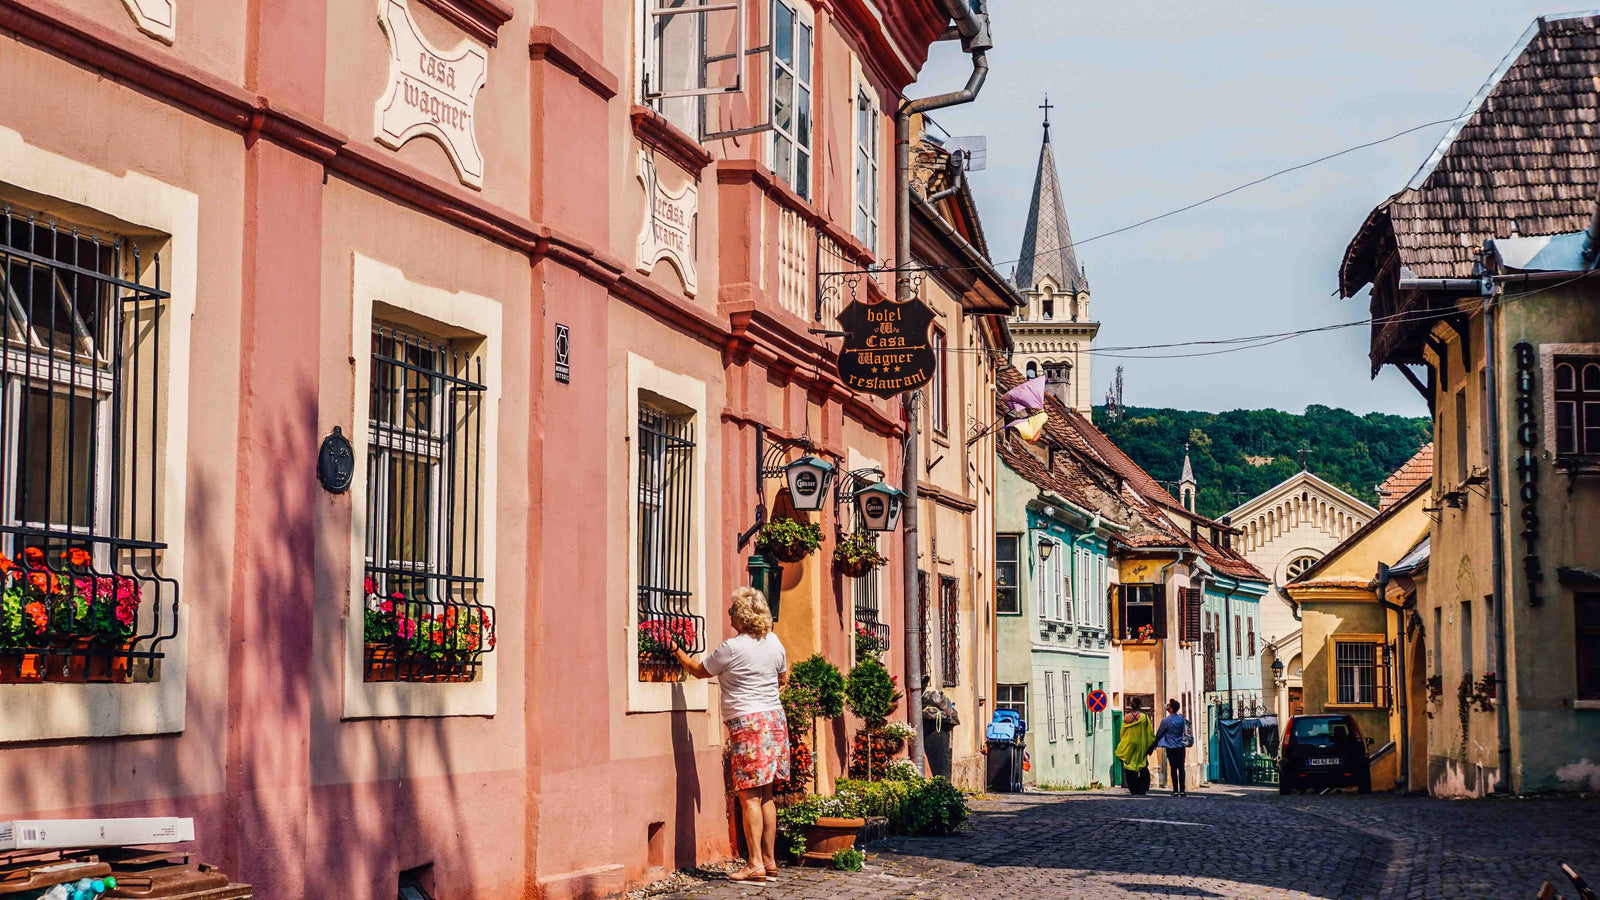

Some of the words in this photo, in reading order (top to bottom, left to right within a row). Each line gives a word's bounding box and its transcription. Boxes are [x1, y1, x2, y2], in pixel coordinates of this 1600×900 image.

[419, 52, 457, 91] casa
[403, 77, 467, 132] wagner
[867, 307, 902, 322] hotel
[865, 335, 906, 348] Casa
[857, 352, 914, 366] Wagner
[849, 368, 927, 390] restaurant
